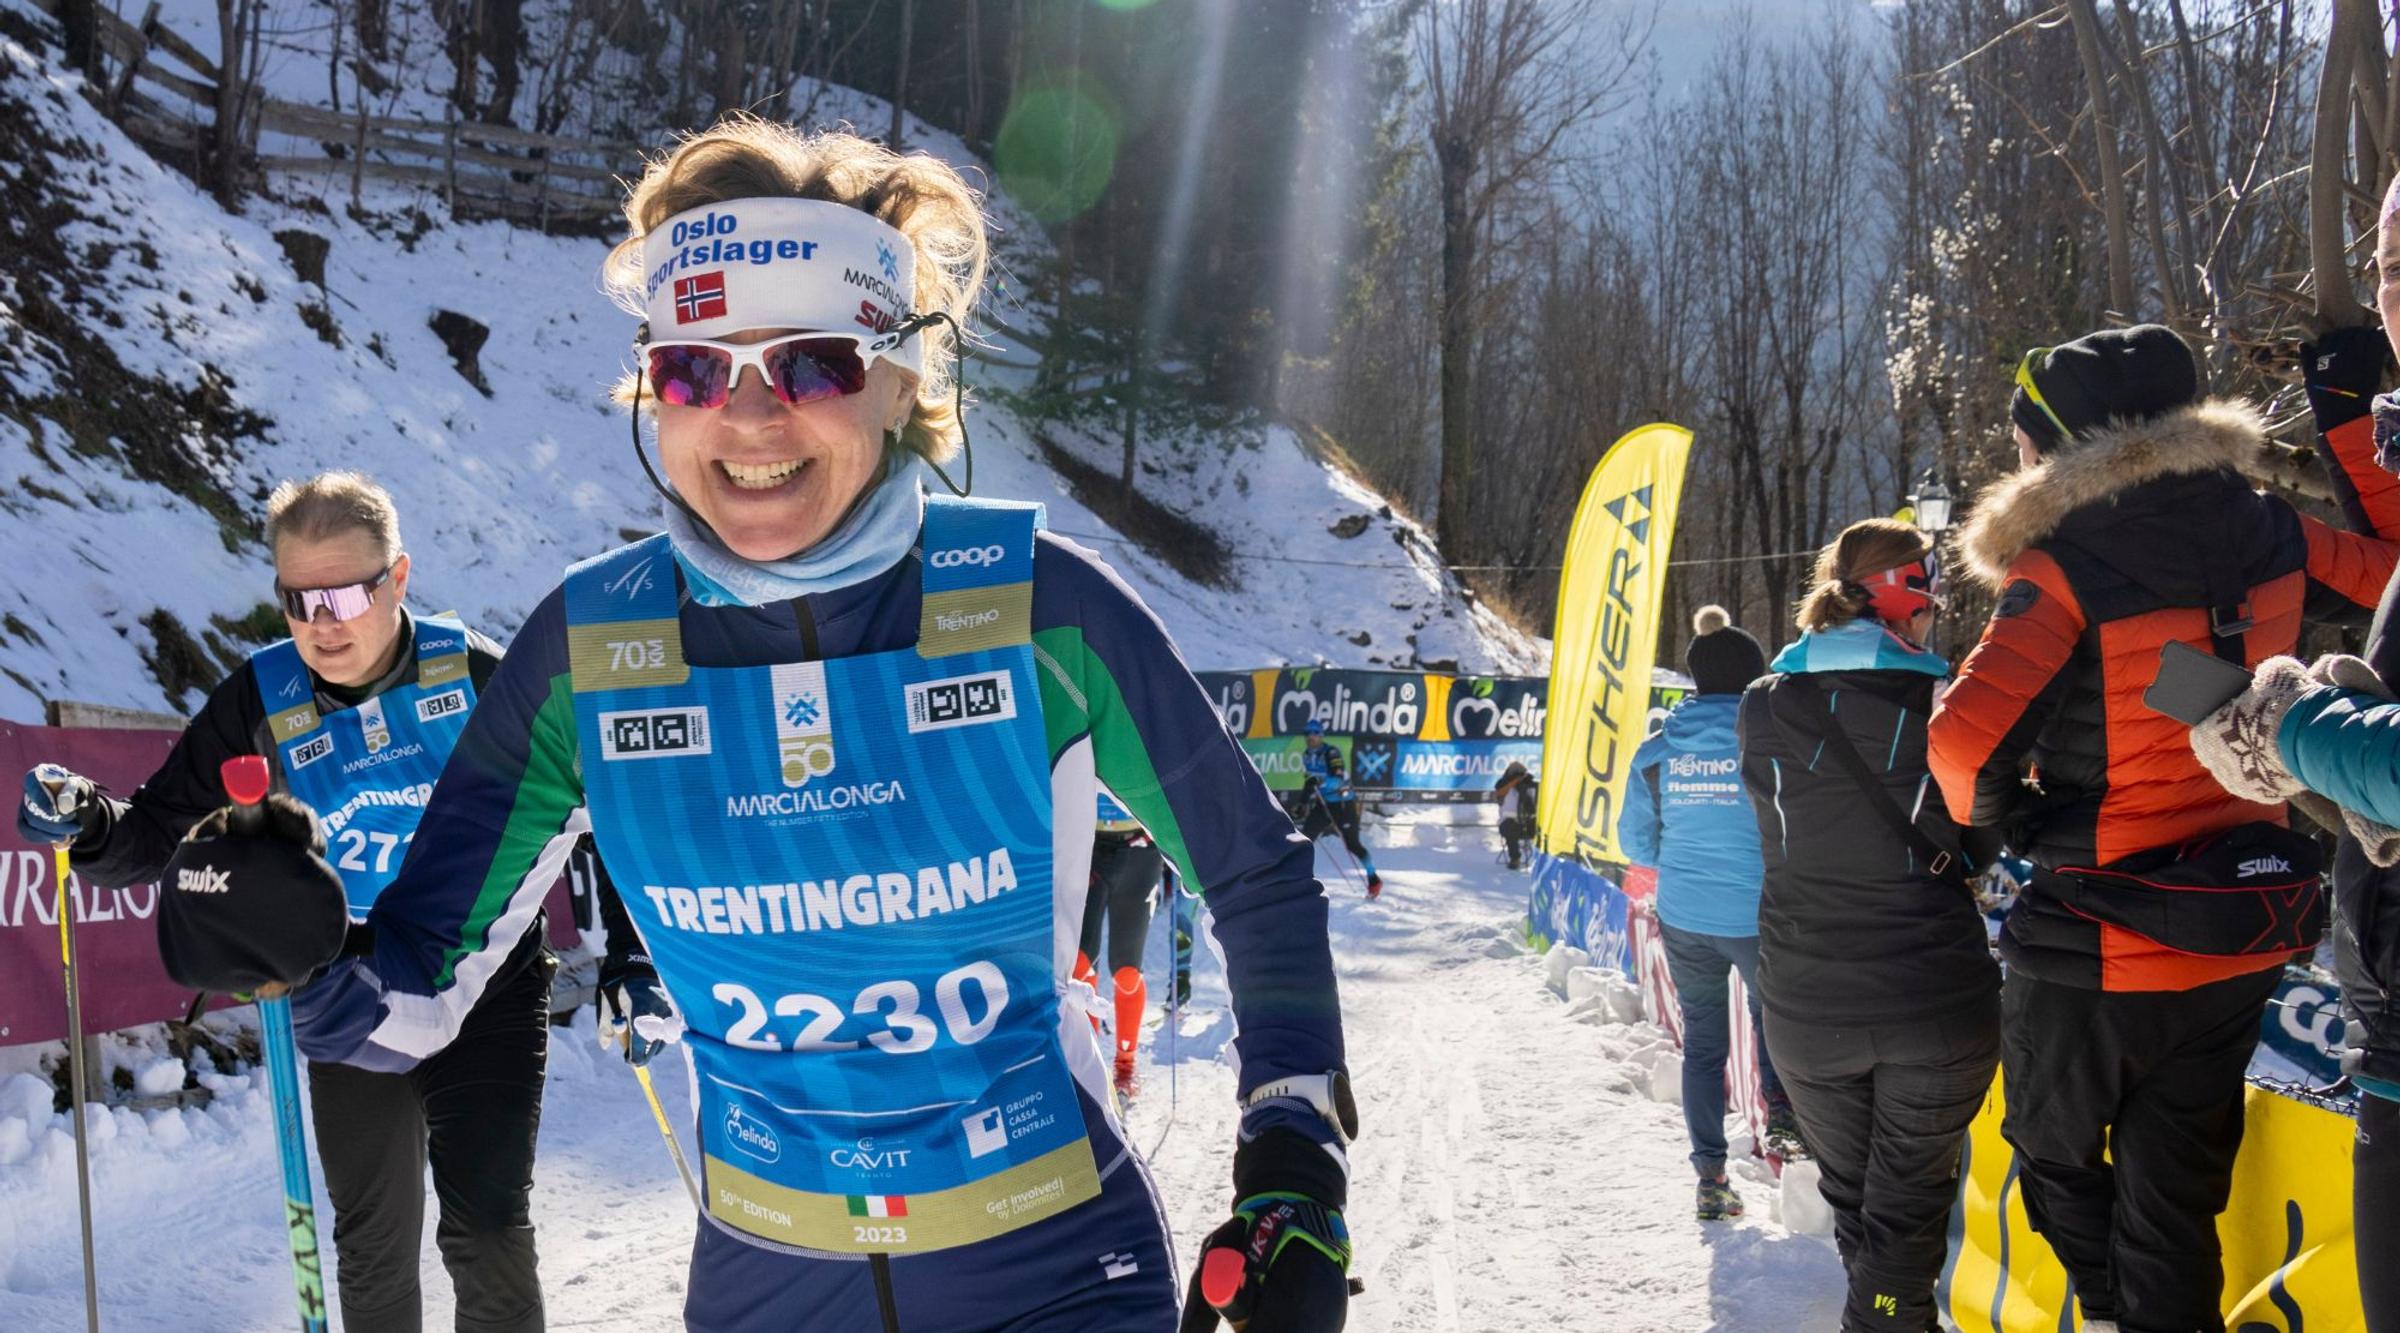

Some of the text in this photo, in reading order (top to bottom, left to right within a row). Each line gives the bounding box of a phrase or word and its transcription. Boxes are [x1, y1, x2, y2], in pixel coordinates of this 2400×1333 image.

[671, 212, 737, 247] Oslo
[930, 544, 1005, 568] coop
[935, 609, 1000, 632] TRENTINO
[419, 639, 455, 651] coop
[605, 641, 646, 672] 70
[285, 713, 304, 731] 70
[342, 743, 424, 775] MARCIALONGA
[1667, 757, 1738, 777] TRENTINO
[319, 779, 439, 838] TRENTINGR
[727, 780, 906, 818] MARCIALONGA
[336, 828, 416, 873] 27
[177, 864, 232, 893] swix
[643, 847, 1018, 935] TRENTINGRANA
[711, 960, 1010, 1054] 2230
[1005, 1091, 1043, 1115] GRUPPO
[1008, 1108, 1038, 1127] CASSA
[1011, 1114, 1055, 1139] CENTRALE
[727, 1118, 778, 1153] Melinda
[830, 1149, 912, 1171] CAVIT
[742, 1199, 792, 1228] EDITION
[986, 1198, 1008, 1214] Get
[853, 1226, 908, 1244] 2023
